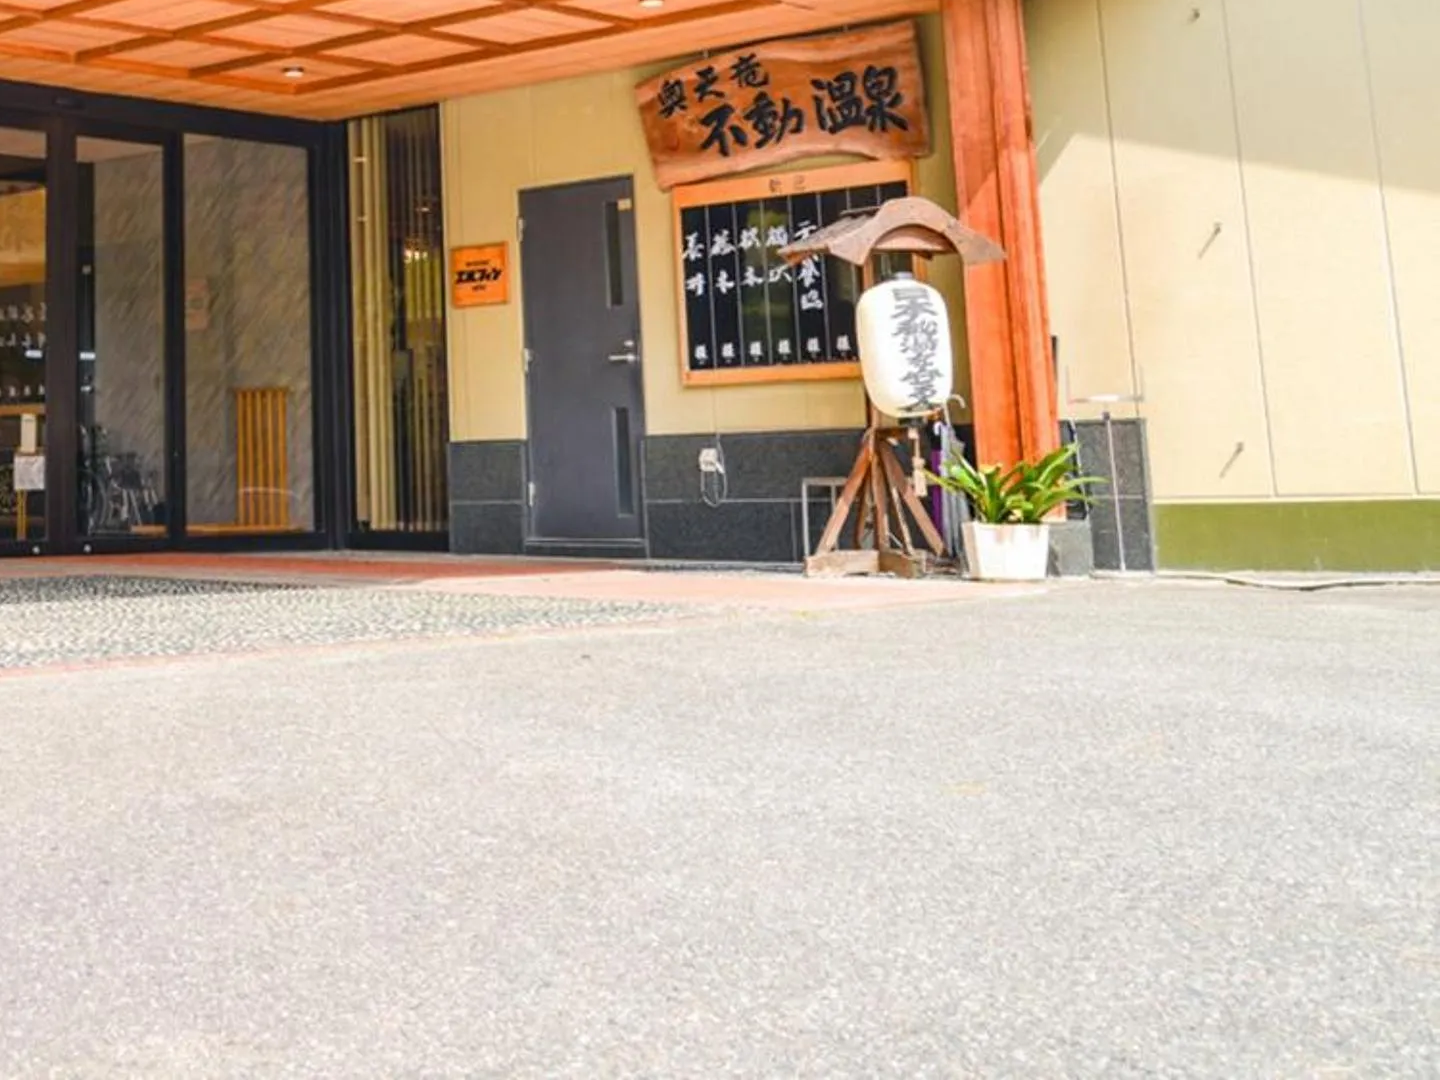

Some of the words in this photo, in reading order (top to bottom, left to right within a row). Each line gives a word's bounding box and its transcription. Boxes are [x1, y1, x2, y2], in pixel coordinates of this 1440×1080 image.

[658, 53, 770, 119] 奥天竜
[699, 65, 908, 157] 不動温泉
